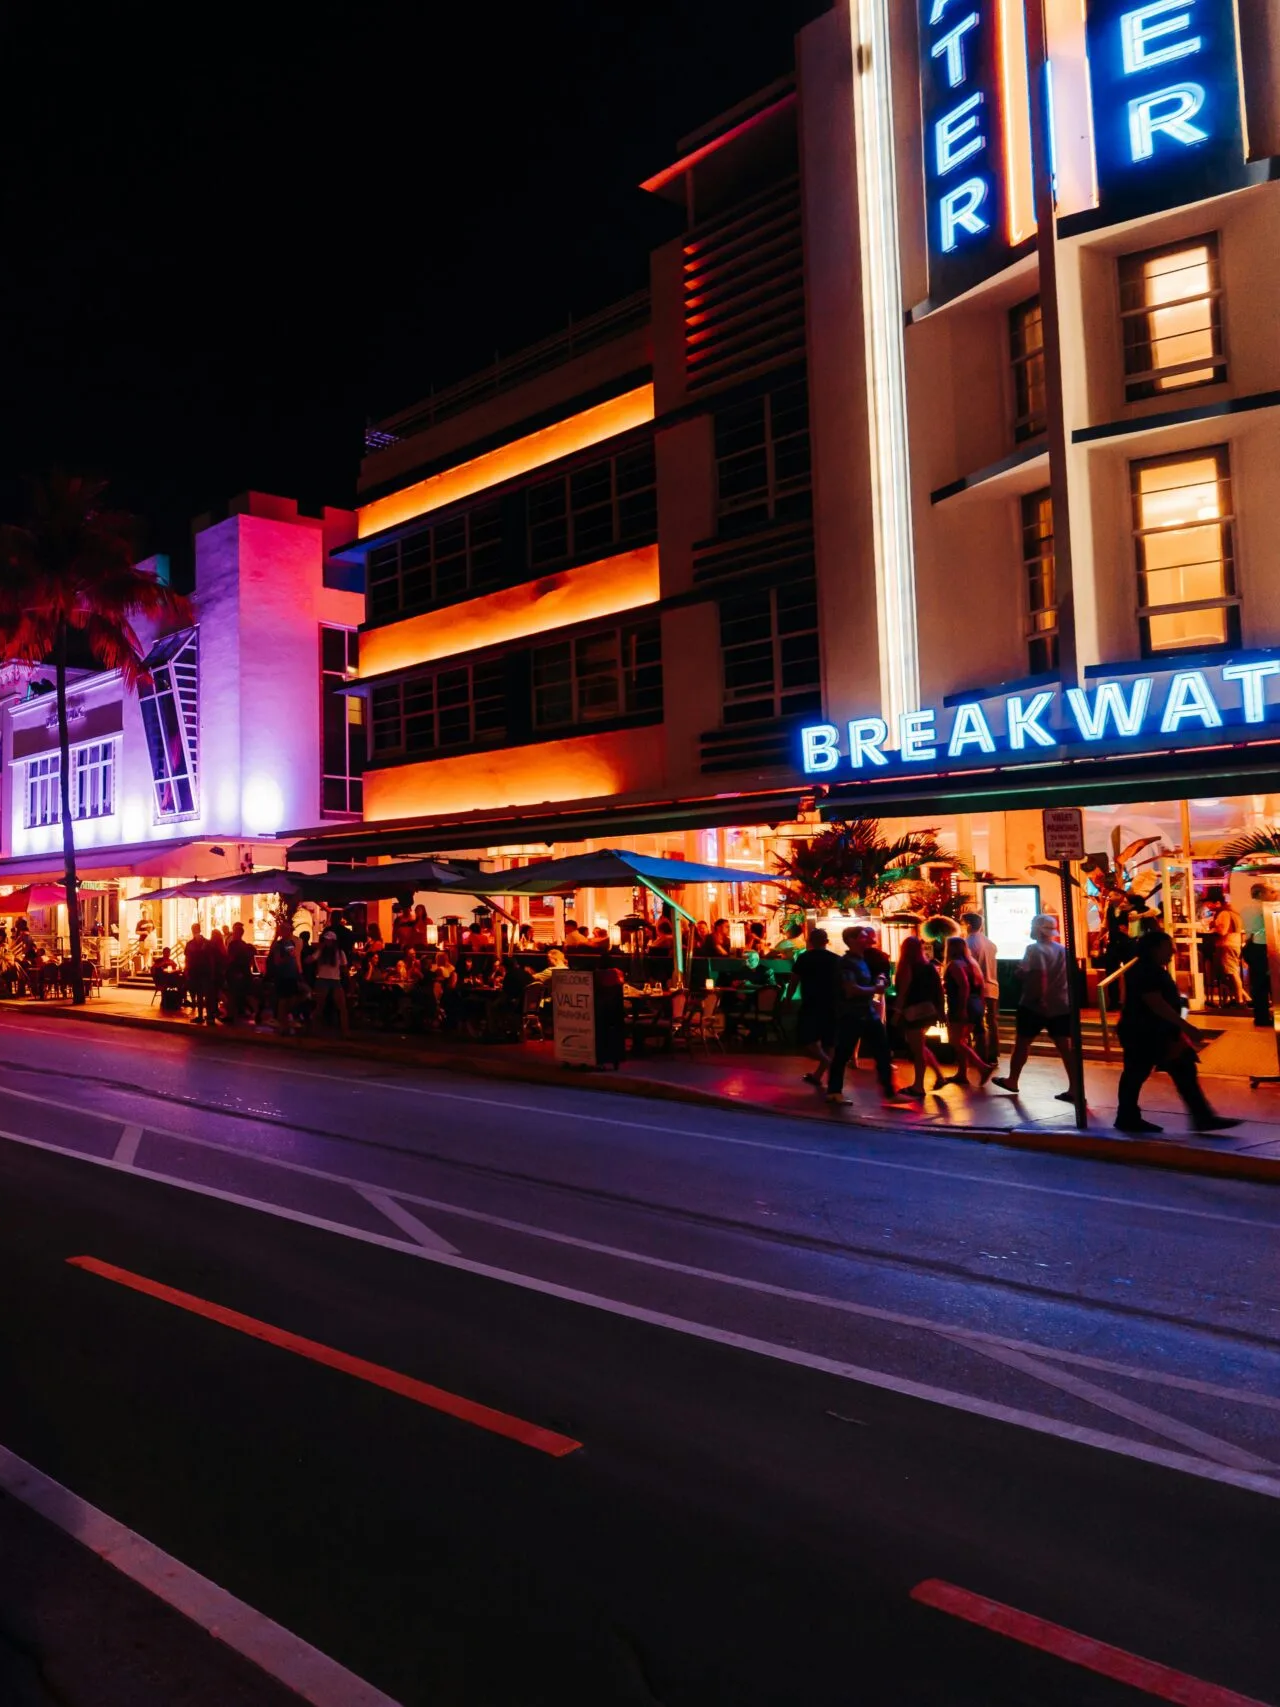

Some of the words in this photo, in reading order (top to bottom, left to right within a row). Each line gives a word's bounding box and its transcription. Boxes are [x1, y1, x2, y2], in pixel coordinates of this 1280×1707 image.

[1120, 0, 1208, 163] ER
[801, 660, 1280, 774] BREAKWAT
[556, 992, 590, 1008] VALET
[557, 1010, 590, 1021] PARKING
